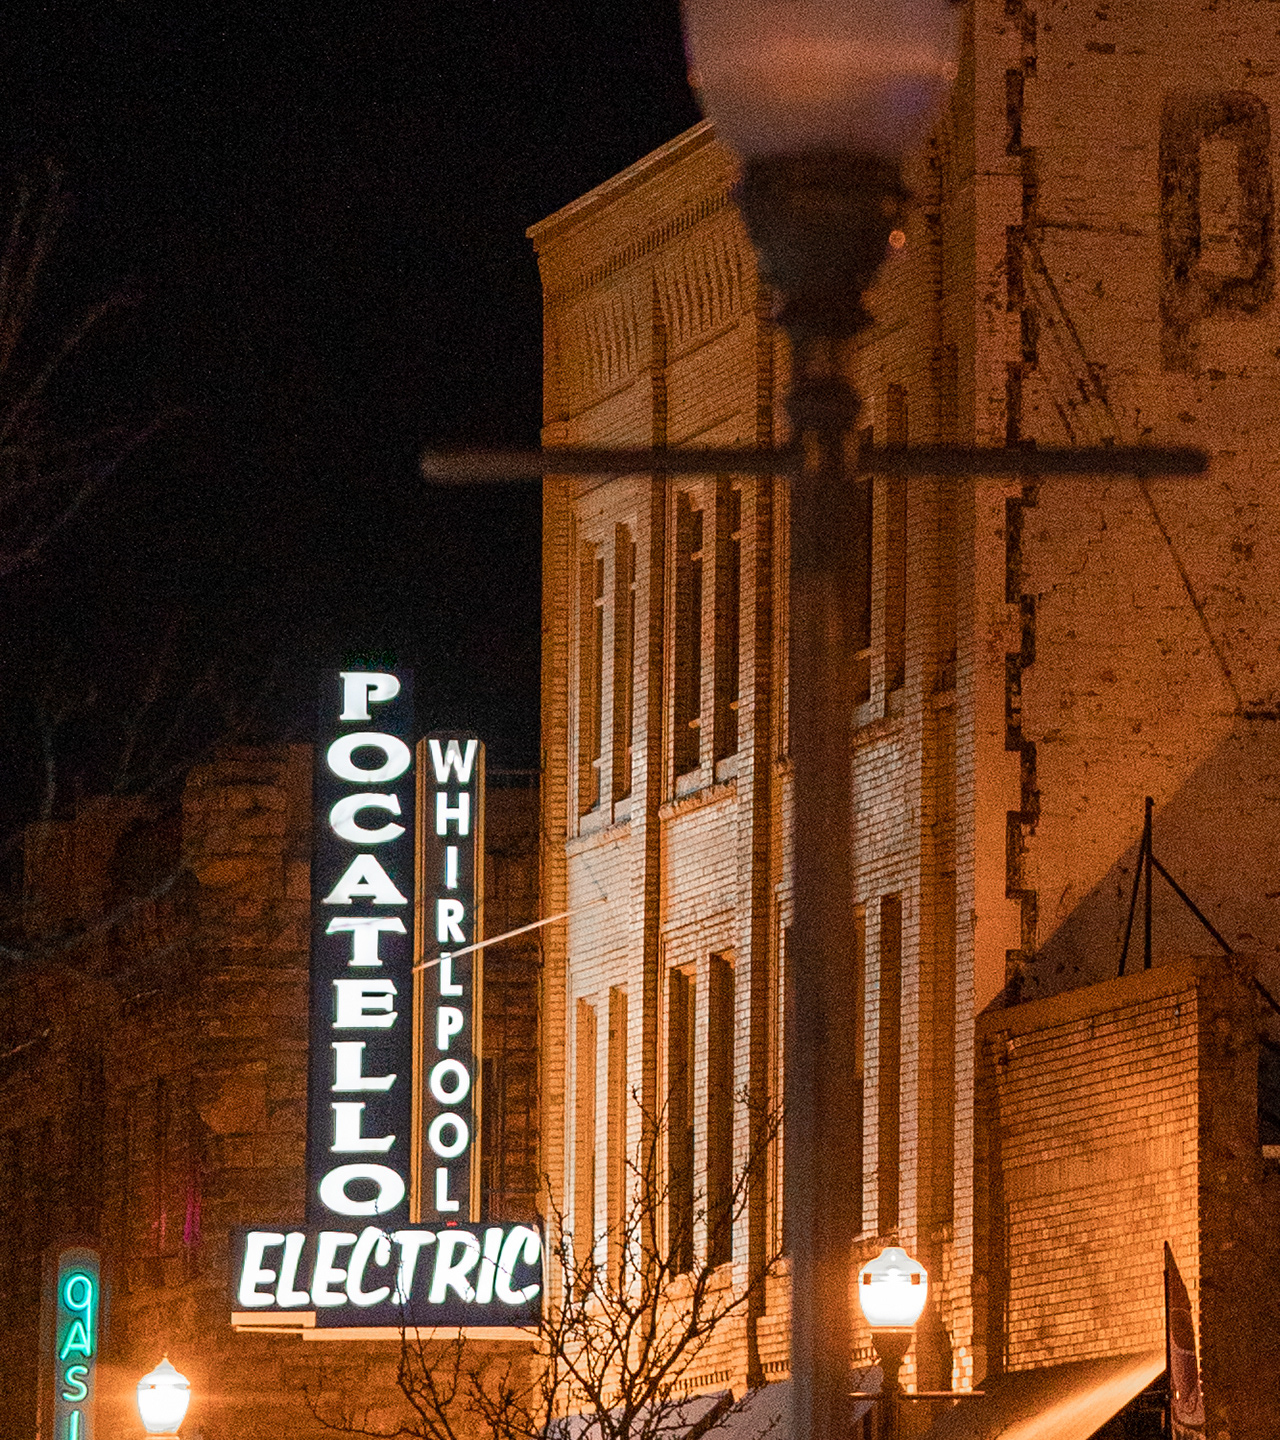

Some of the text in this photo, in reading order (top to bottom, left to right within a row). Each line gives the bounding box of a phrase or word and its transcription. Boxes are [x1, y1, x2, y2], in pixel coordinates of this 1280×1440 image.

[320, 671, 411, 1217] POCATELLO
[428, 738, 478, 1213] WHIRLPOOL
[237, 1224, 544, 1308] ELECTRIC
